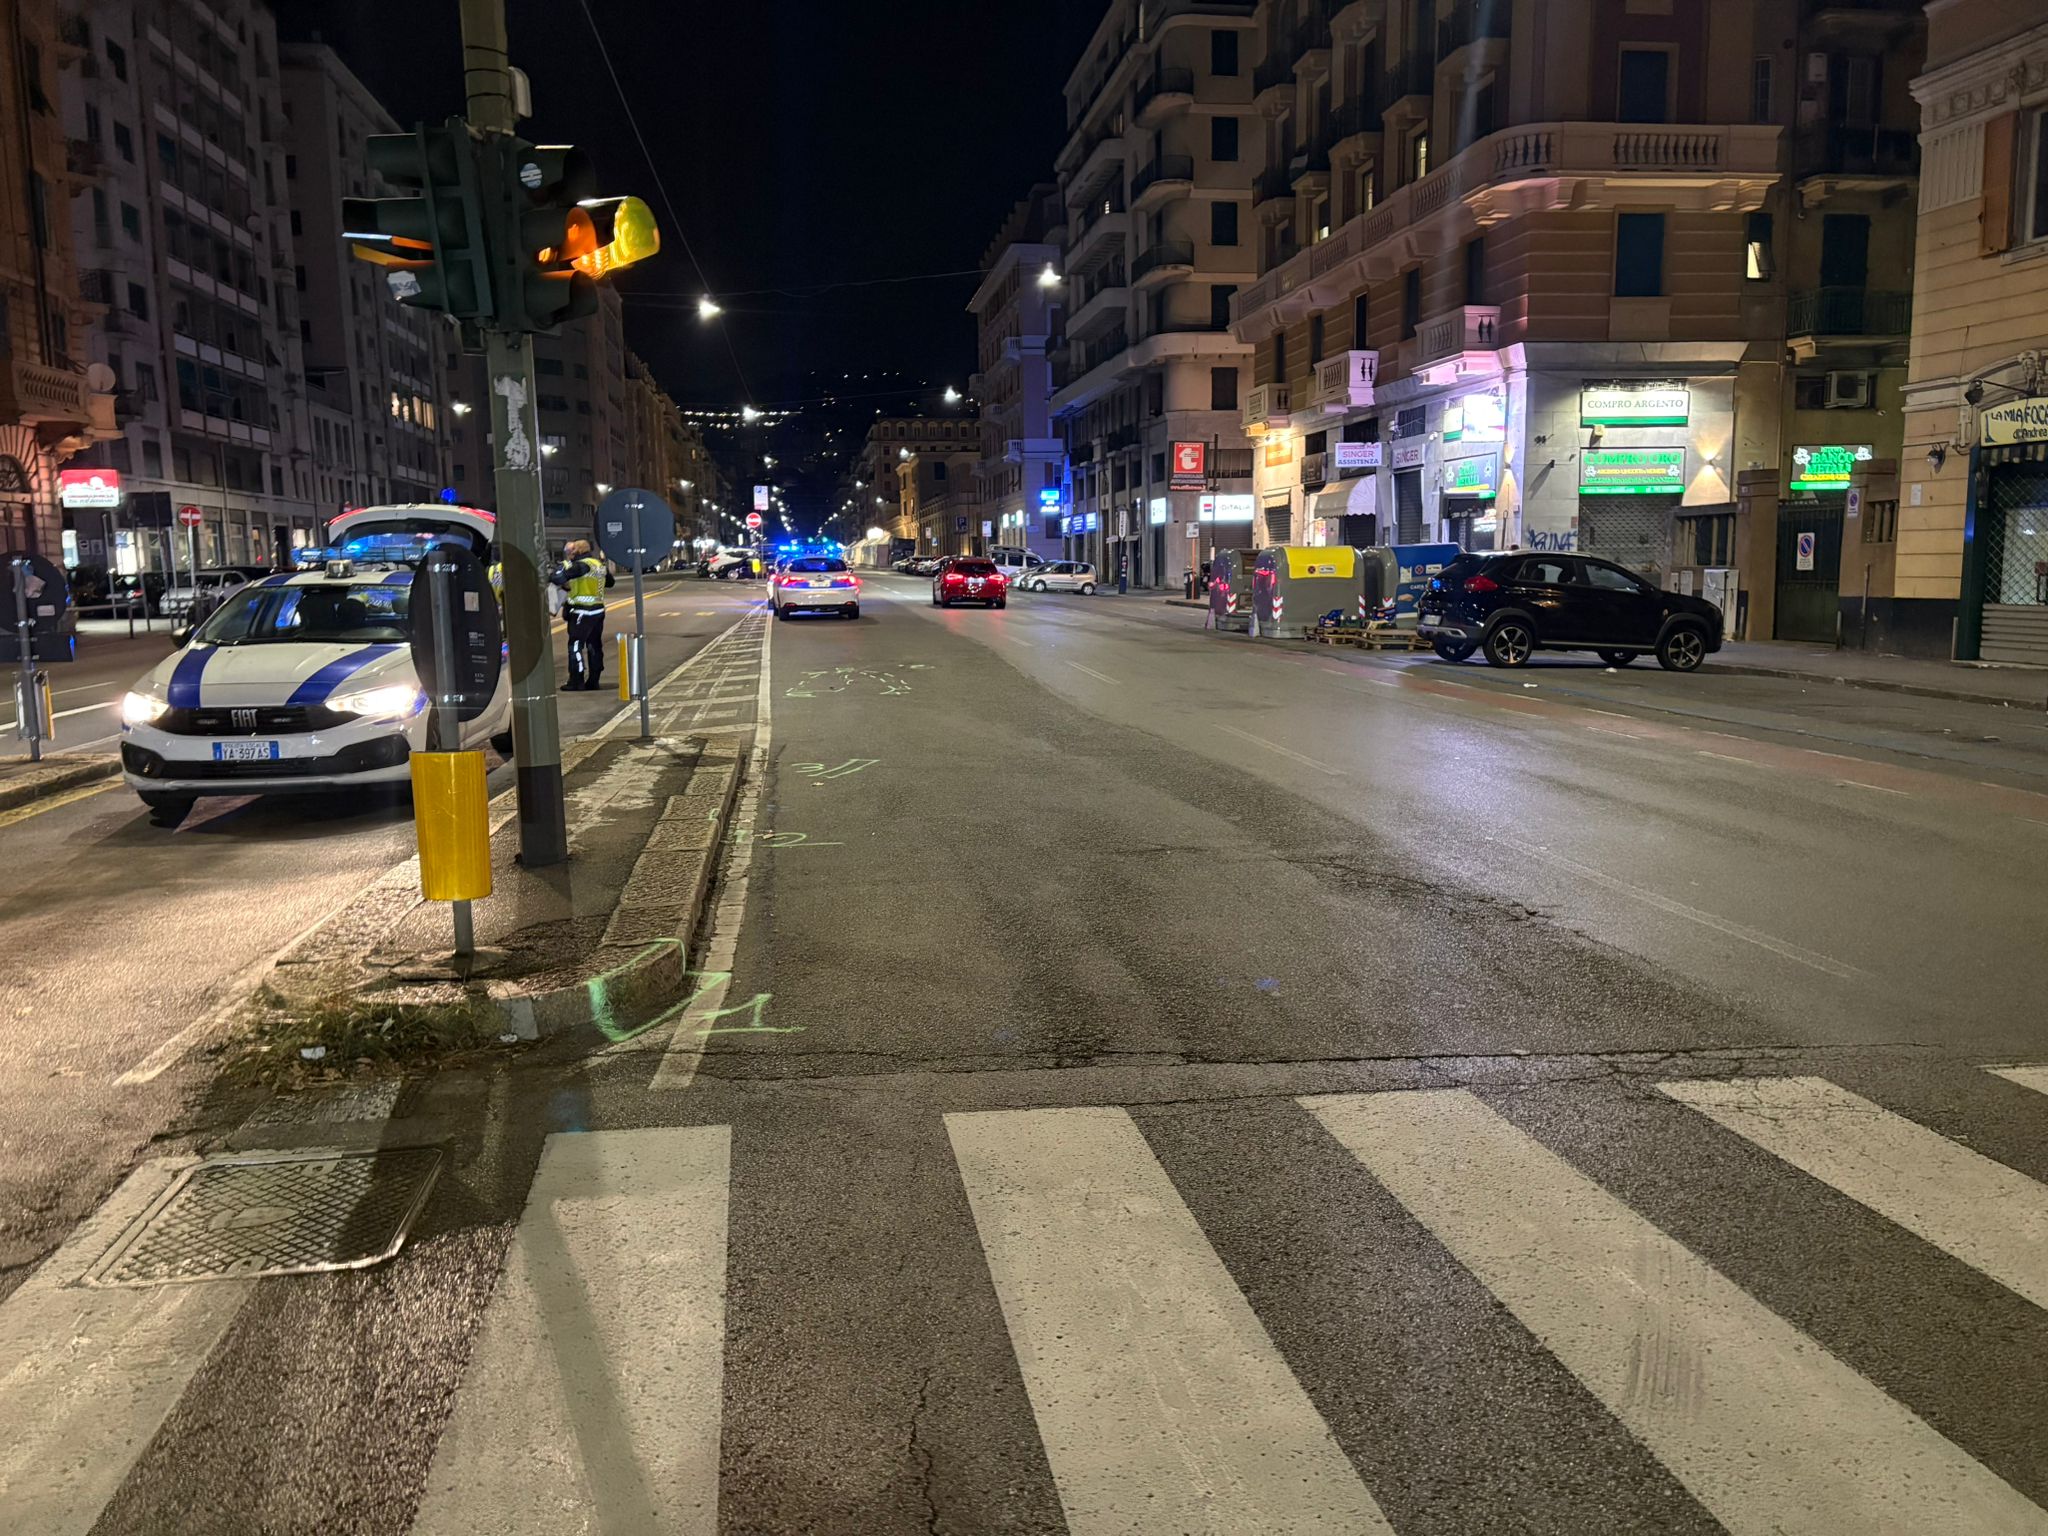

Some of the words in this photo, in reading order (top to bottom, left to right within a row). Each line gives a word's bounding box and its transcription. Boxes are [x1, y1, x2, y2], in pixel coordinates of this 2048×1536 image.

[1587, 399, 1632, 409] COMPRO
[1634, 399, 1684, 408] ARGENTO
[1991, 411, 2002, 421] LA
[2004, 407, 2023, 423] MIA
[1342, 450, 1375, 458] SINGER
[1395, 449, 1419, 464] SINGER
[1584, 452, 1647, 465] COMPRO
[1649, 452, 1681, 465] ORO
[1811, 452, 1856, 463] BANCO
[231, 708, 258, 728] FIAT
